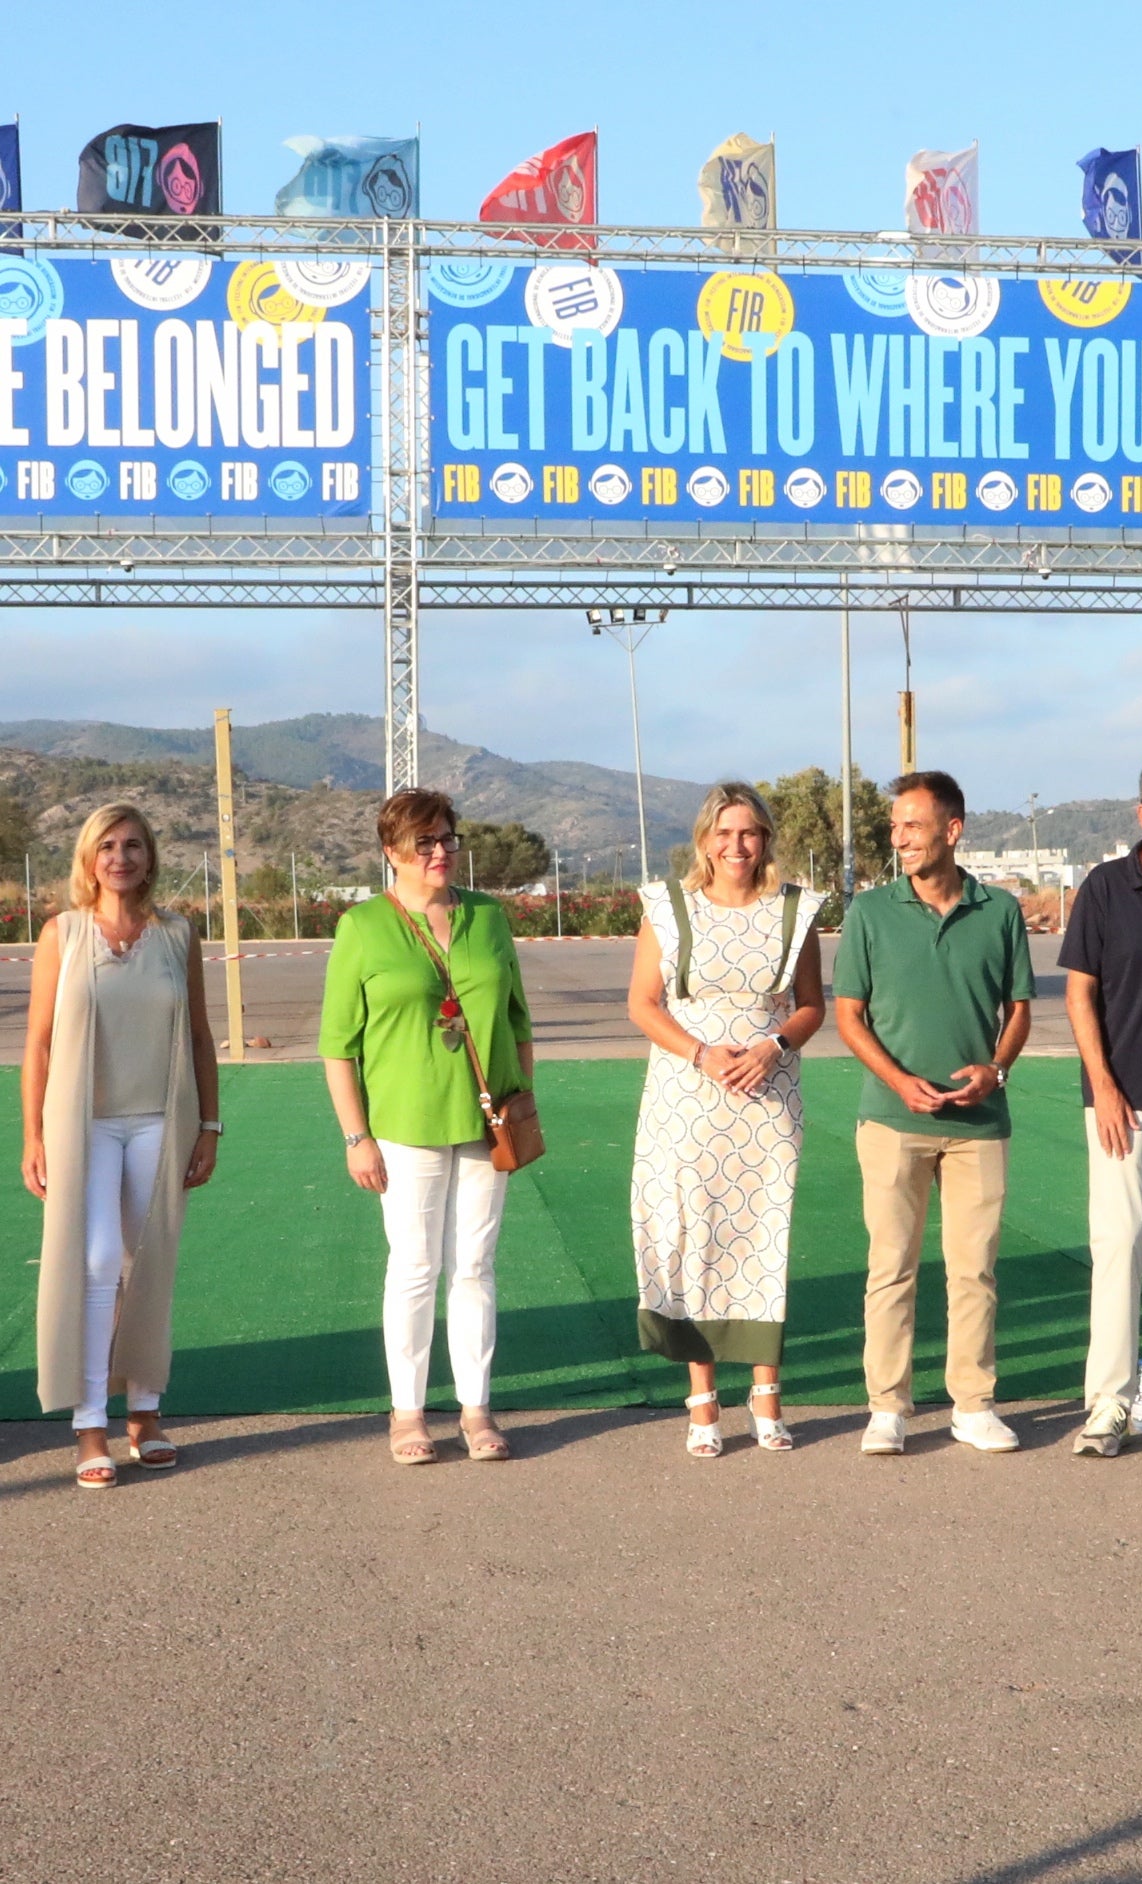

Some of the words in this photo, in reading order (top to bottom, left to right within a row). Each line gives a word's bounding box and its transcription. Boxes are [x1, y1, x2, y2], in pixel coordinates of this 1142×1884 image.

[548, 276, 599, 320] FIB
[726, 287, 765, 334] FIB
[45, 317, 356, 449] BELONGED
[446, 322, 554, 451] GET
[570, 327, 728, 454] BACK
[742, 329, 815, 457] TO
[830, 333, 1030, 459] WHERE
[17, 460, 55, 500] FIB
[119, 461, 157, 501] FIB
[221, 462, 258, 501] FIB
[322, 462, 359, 501] FIB
[443, 465, 480, 502] FIB
[543, 466, 579, 503] FIB
[641, 467, 677, 505] FIB
[739, 469, 774, 506] FIB
[836, 471, 871, 508] FIB
[932, 472, 967, 509] FIB
[1027, 473, 1062, 510] FIB
